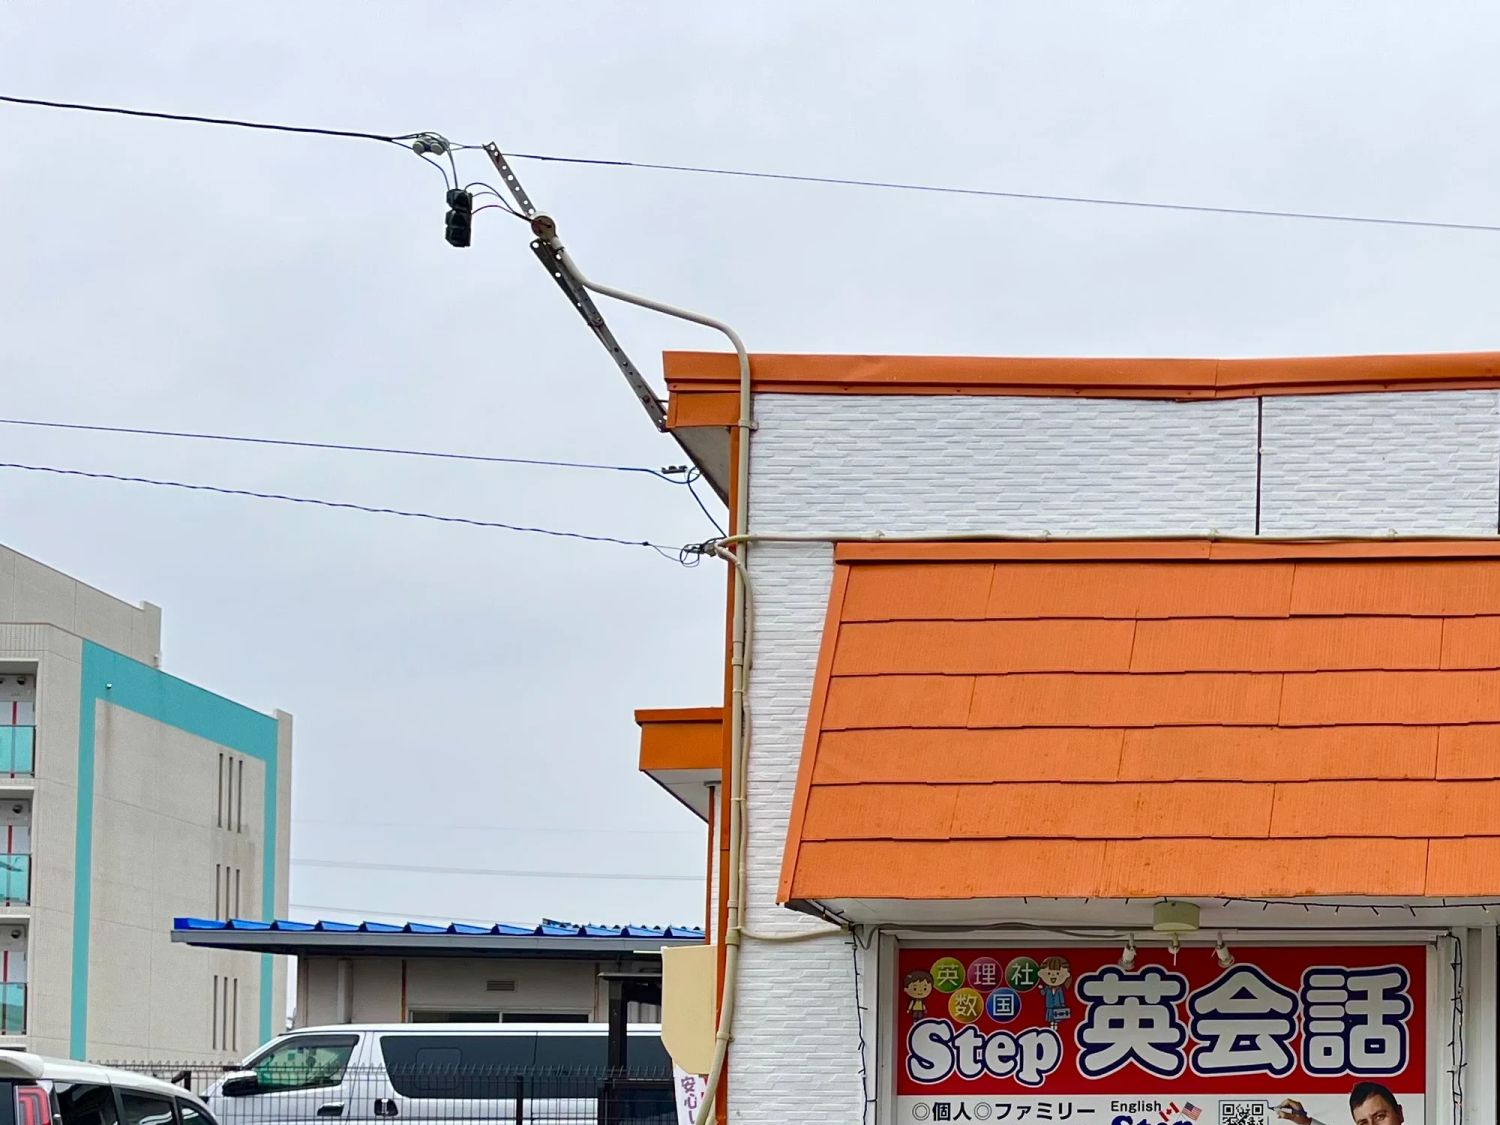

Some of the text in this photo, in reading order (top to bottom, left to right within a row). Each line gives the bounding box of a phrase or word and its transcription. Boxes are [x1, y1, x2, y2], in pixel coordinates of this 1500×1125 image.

[937, 963, 1034, 986] 英 理 社
[955, 994, 1015, 1017] 数 国
[1076, 965, 1413, 1078] 英会話
[908, 1019, 1061, 1086] Step
[1110, 1100, 1162, 1113] English
